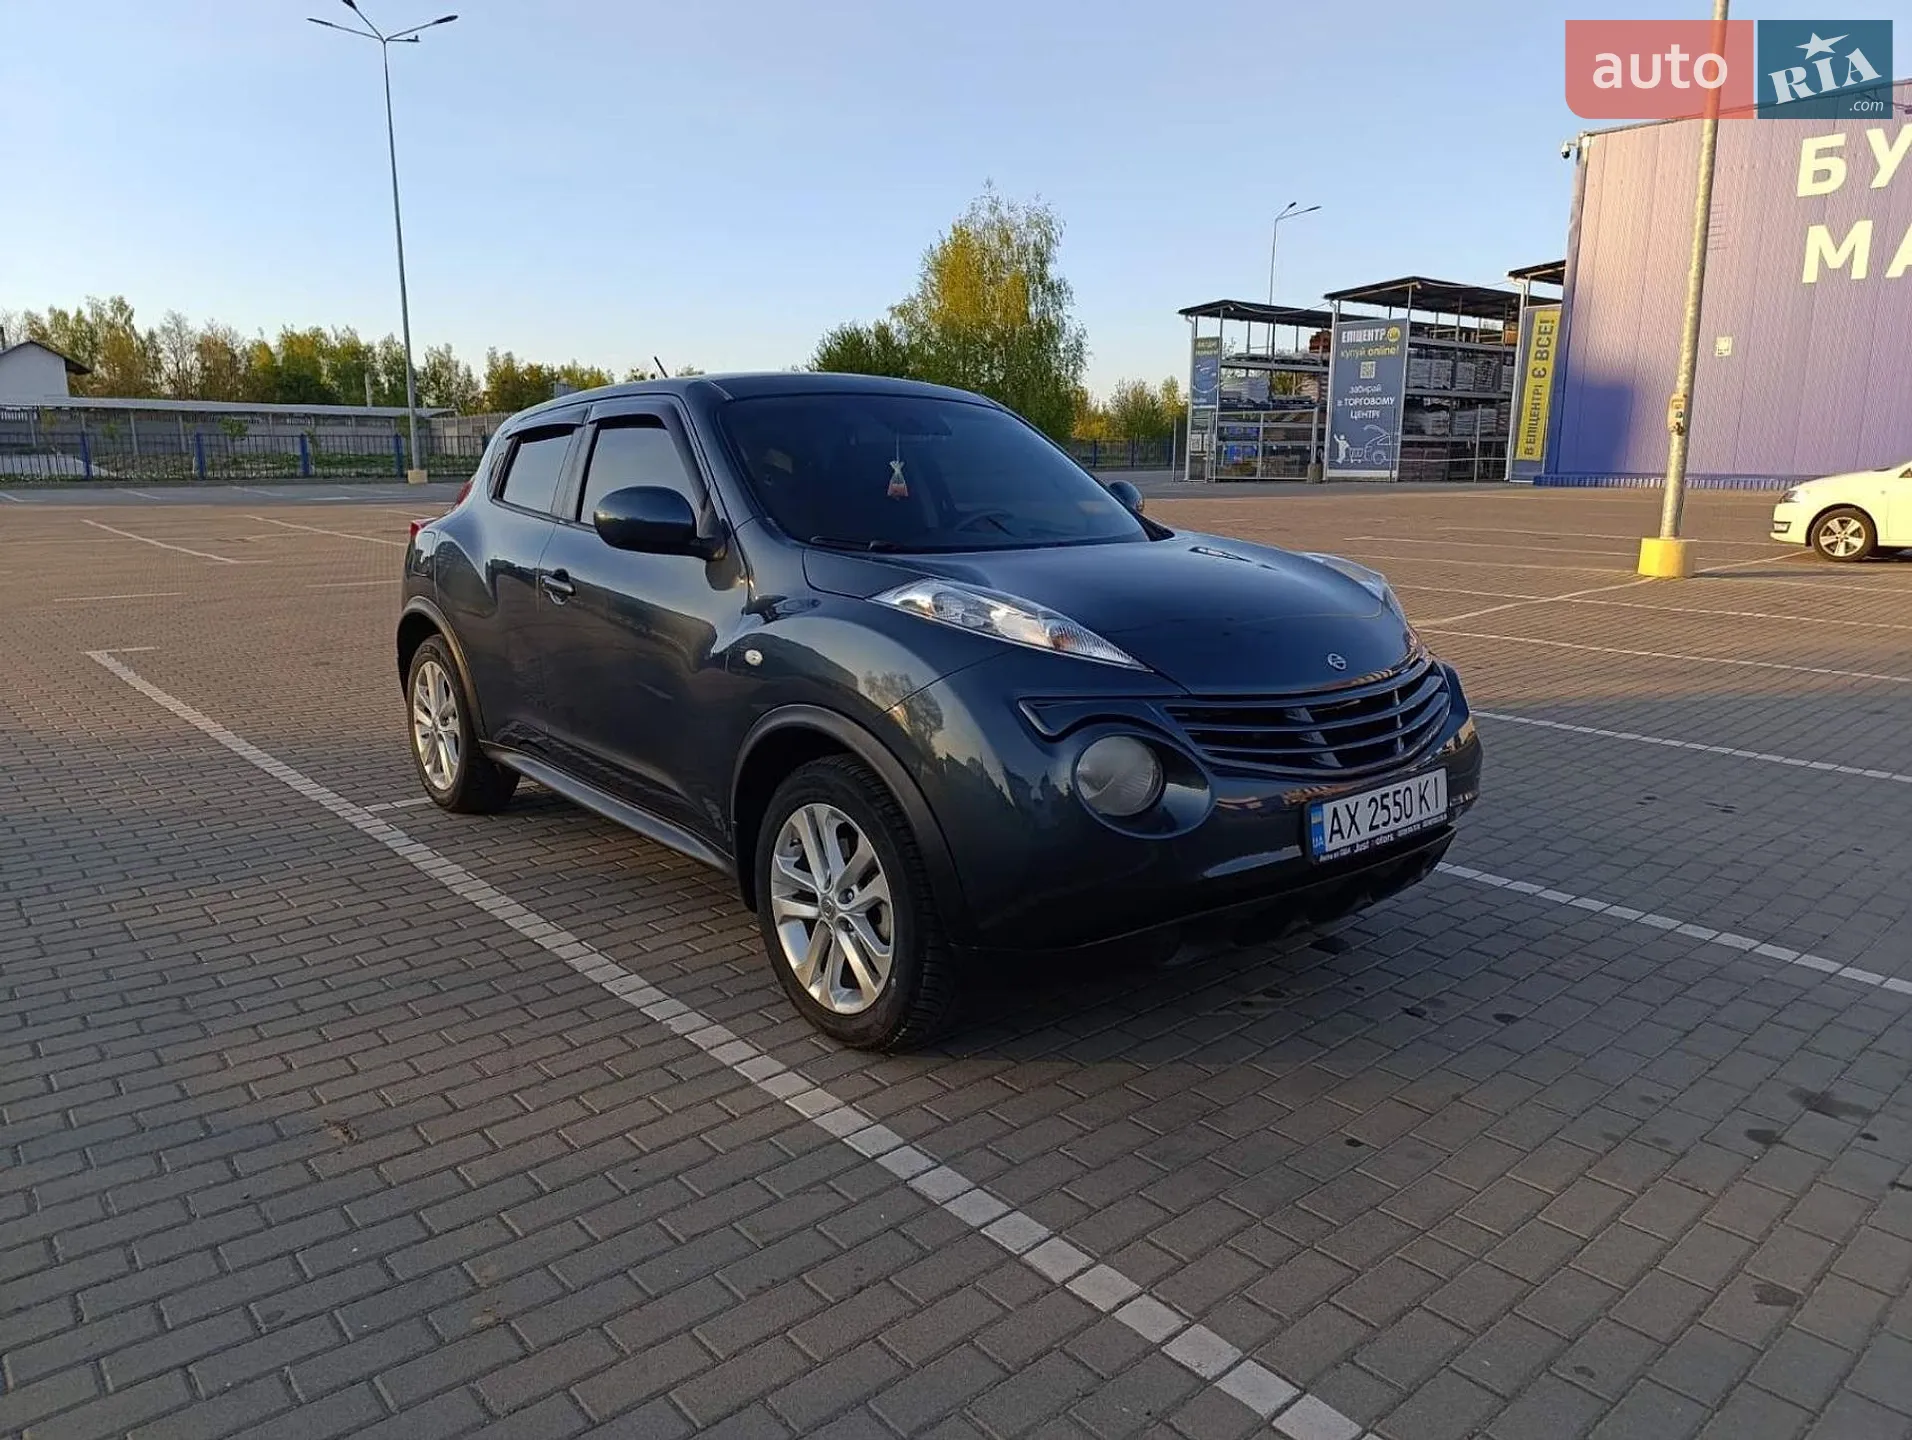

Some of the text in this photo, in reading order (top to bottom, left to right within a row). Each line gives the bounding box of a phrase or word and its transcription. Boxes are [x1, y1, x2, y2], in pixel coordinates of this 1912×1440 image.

[1534, 319, 1555, 361] ВСЕ!
[1345, 396, 1395, 406] ТОРГОВОМУ
[1328, 776, 1439, 844] AX 2550 KI
[1312, 836, 1324, 849] UA
